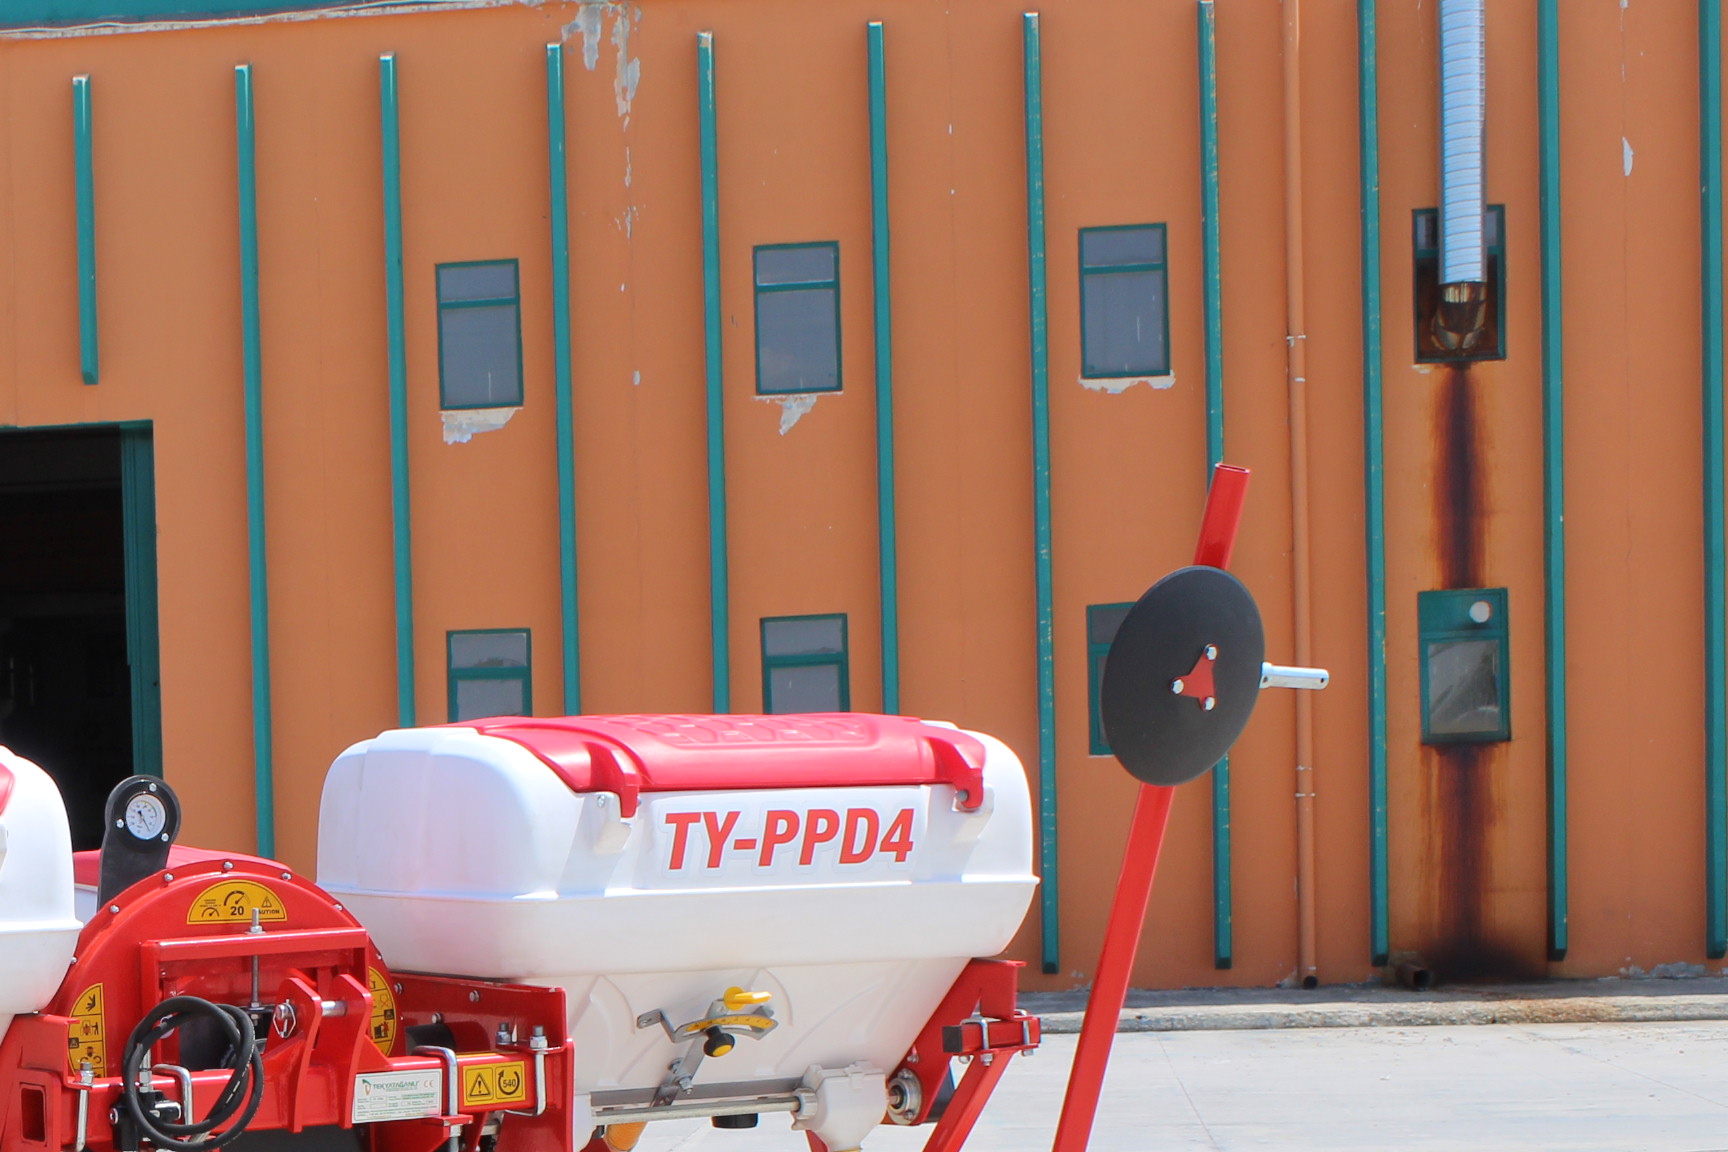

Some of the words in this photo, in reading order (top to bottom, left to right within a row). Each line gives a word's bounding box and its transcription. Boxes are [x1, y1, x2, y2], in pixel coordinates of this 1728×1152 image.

[665, 808, 915, 870] TY-PPD4
[230, 906, 245, 916] 20
[502, 1078, 517, 1088] 540
